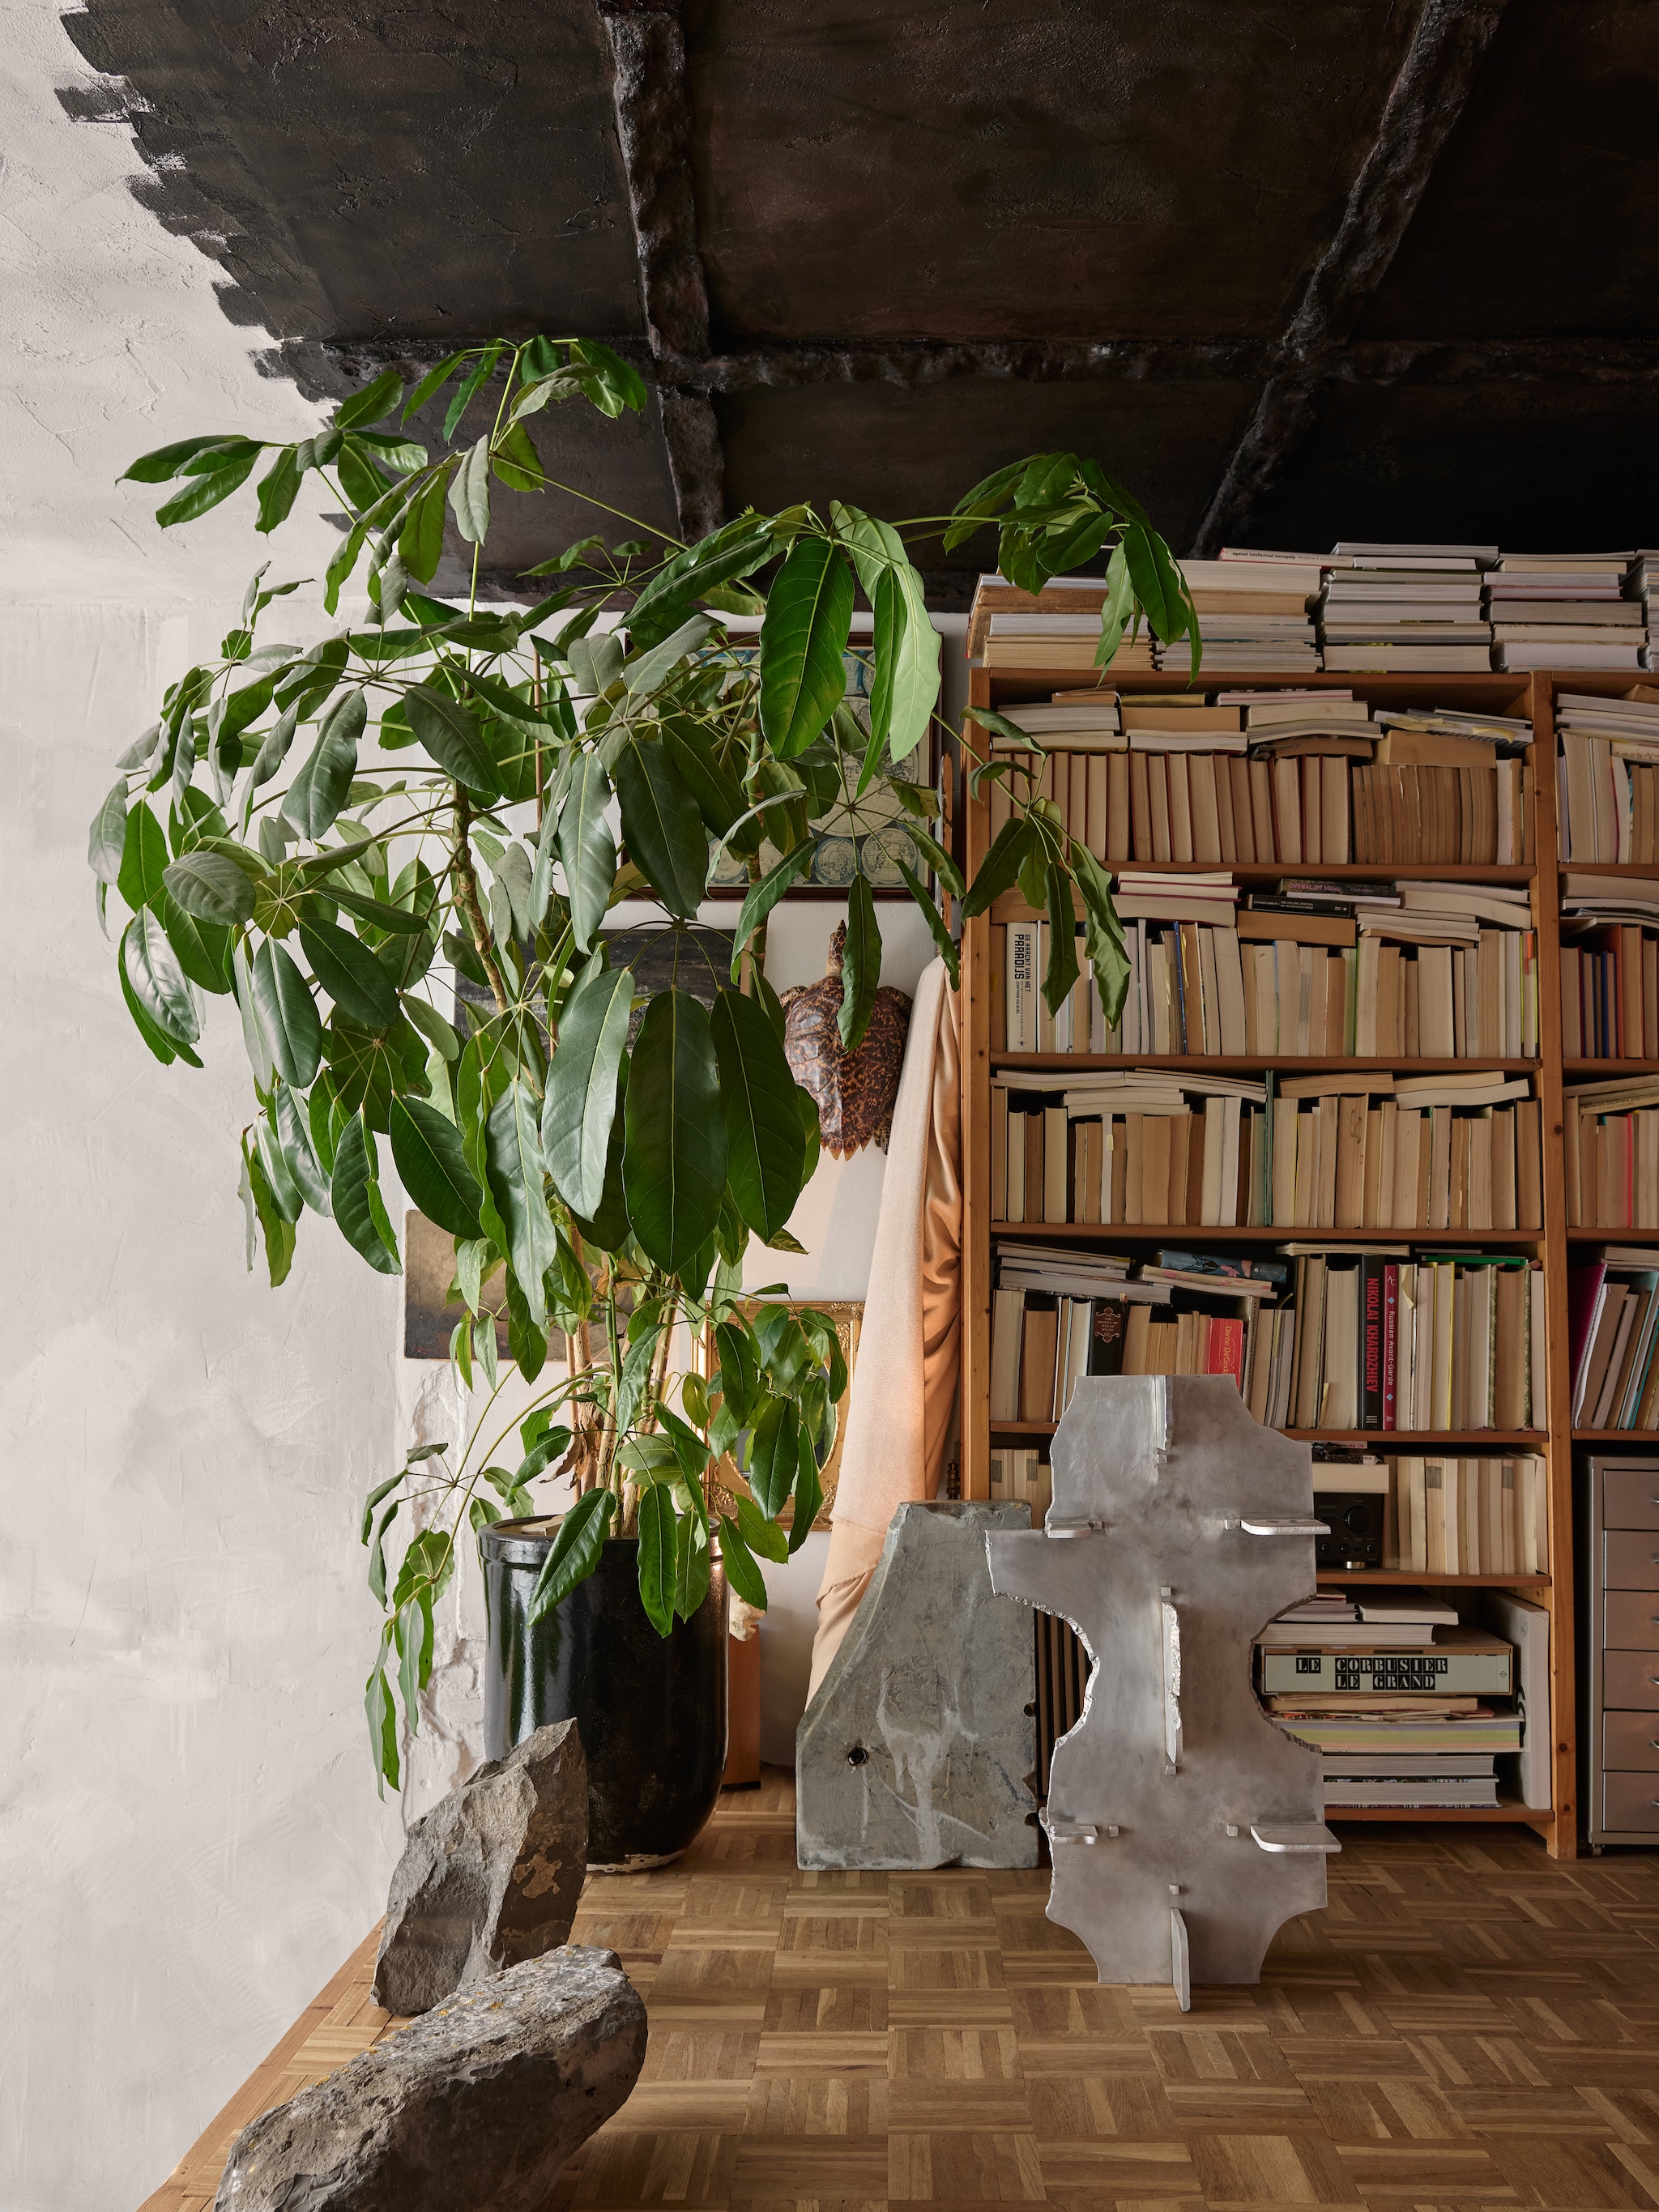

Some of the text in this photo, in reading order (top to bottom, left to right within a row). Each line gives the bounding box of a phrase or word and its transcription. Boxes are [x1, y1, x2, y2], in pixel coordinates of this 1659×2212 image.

[1014, 934, 1025, 979] PARADIJS
[1224, 1326, 1232, 1345] Dante
[1366, 1277, 1379, 1392] NIKOLAI KHARDZHIEV
[1223, 1347, 1231, 1357] De
[1388, 1311, 1396, 1386] Russian Avant-Garde
[1297, 1658, 1447, 1672] LE CORBUSIER
[1337, 1675, 1435, 1688] LE GRAND
